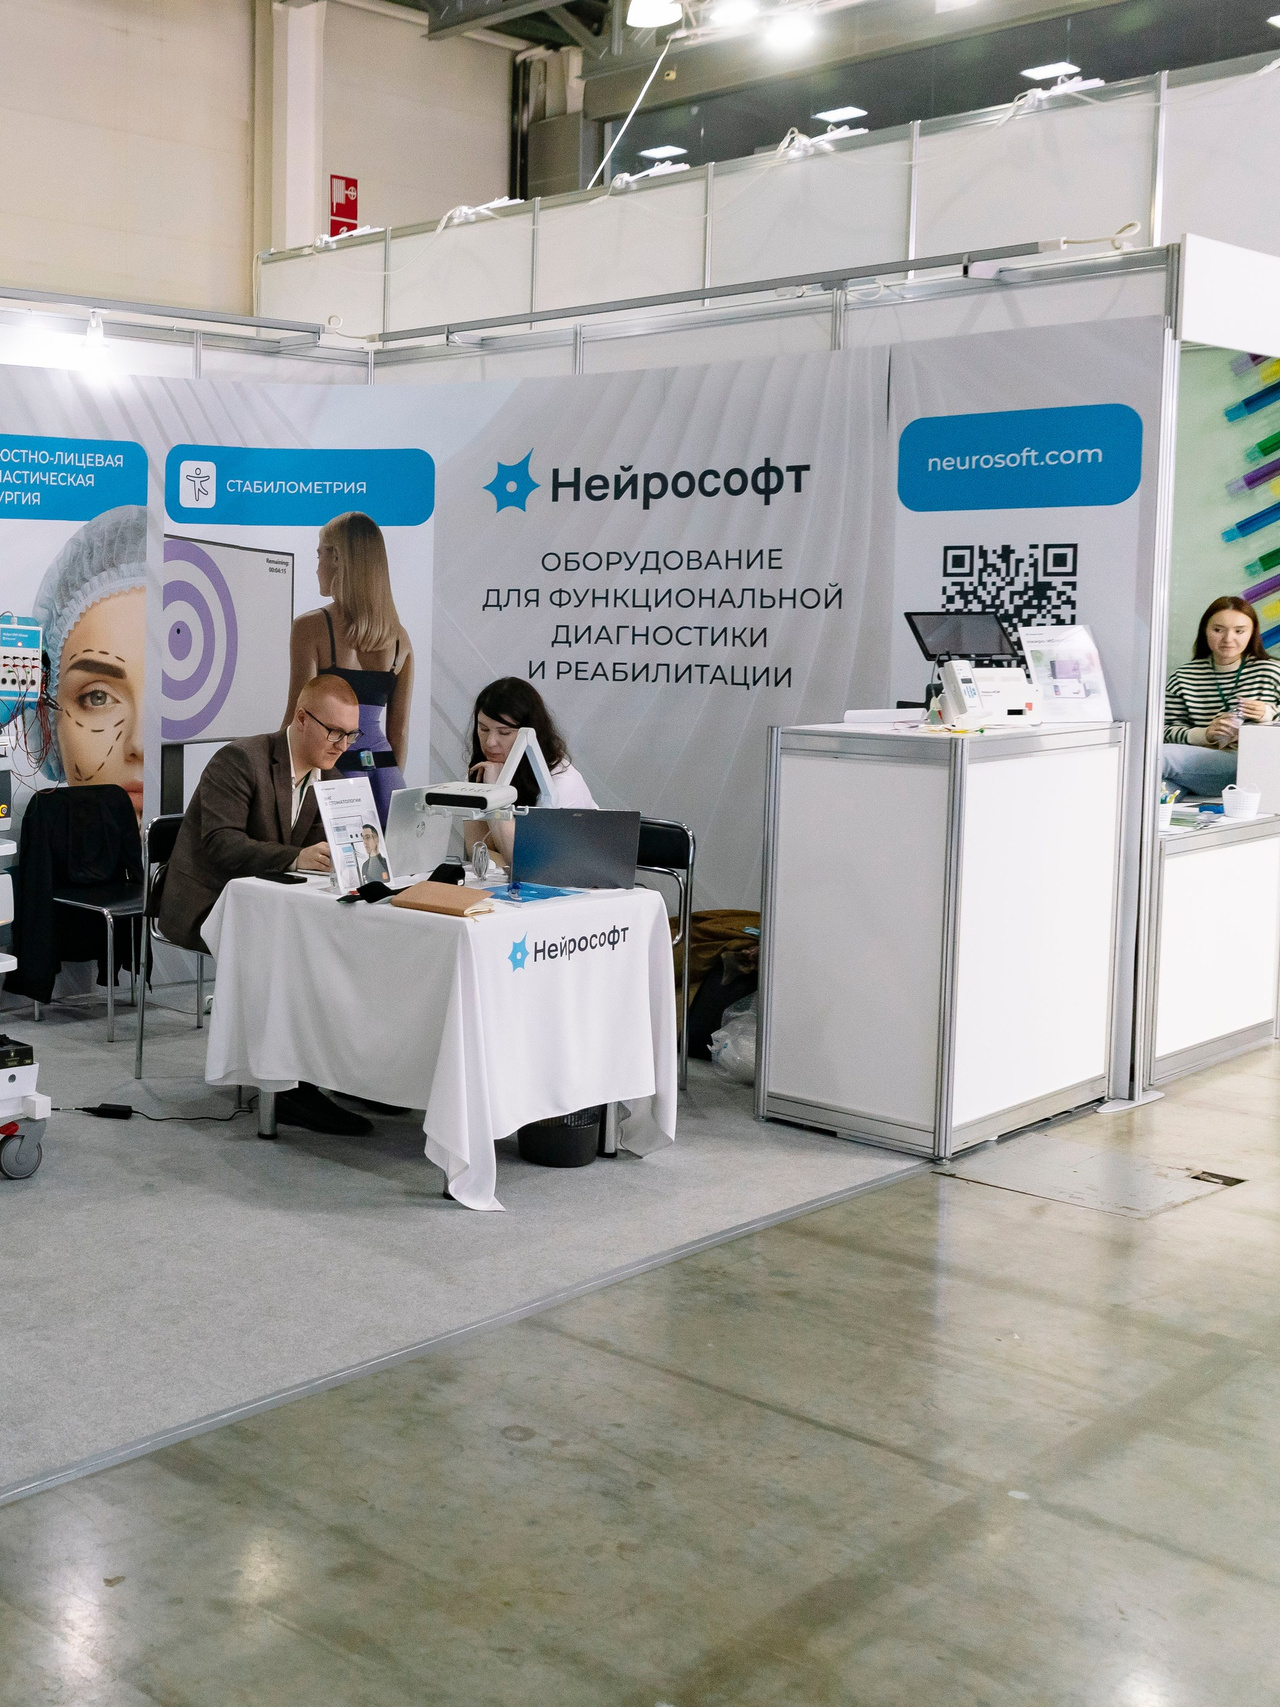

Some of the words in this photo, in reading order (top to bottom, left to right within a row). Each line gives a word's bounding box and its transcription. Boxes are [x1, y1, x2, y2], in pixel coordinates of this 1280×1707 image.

[927, 447, 1103, 472] neurosoft.com
[226, 479, 367, 494] СТАБИЛОМЕТРИЯ
[551, 457, 811, 510] Нейрософт
[541, 548, 784, 575] ОБОРУДОВАНИЕ
[482, 588, 540, 612] ДЛЯ
[549, 582, 843, 612] ФУНКЦИОНАЛЬНОЙ
[551, 624, 768, 648] ДИАГНОСТИКИ
[528, 660, 546, 680] И
[556, 661, 793, 691] РЕАБИЛИТАЦИИ
[533, 925, 629, 962] Нейрософт
